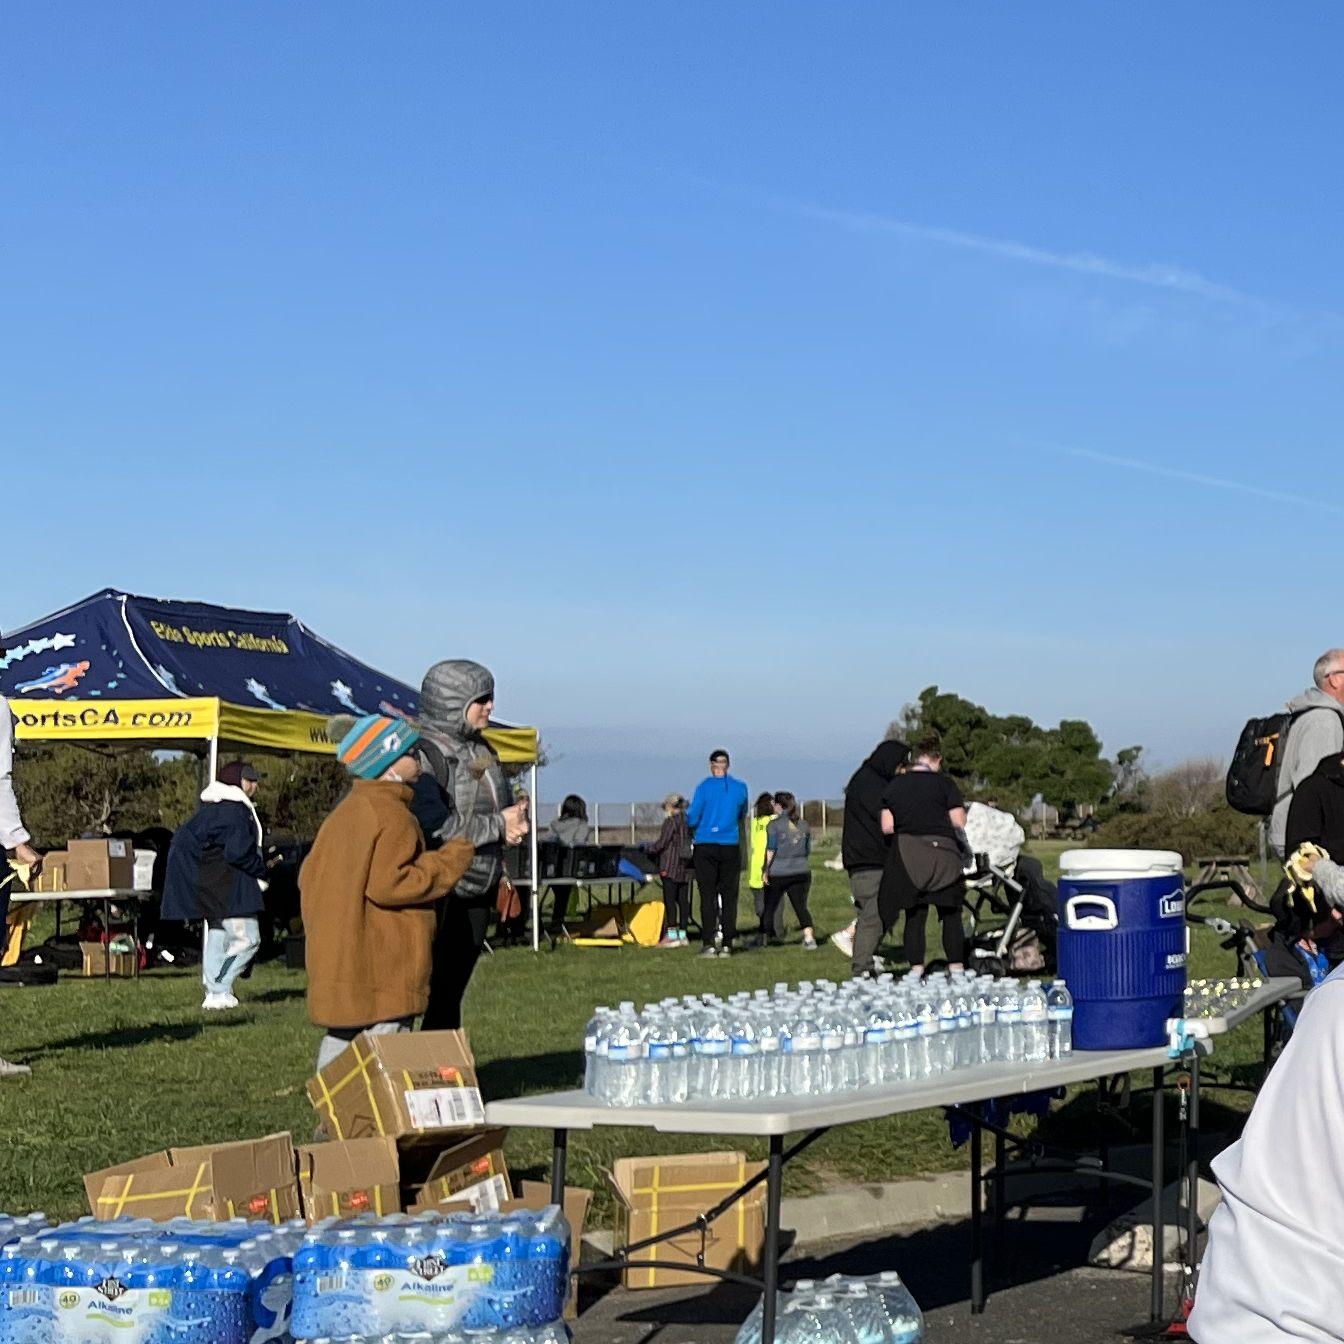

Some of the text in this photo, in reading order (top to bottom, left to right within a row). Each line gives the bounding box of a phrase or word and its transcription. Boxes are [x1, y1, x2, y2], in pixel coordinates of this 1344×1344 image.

[21, 708, 192, 727] ortsCA.com
[401, 1282, 454, 1293] Alkaline
[88, 1301, 133, 1315] Alkaline
